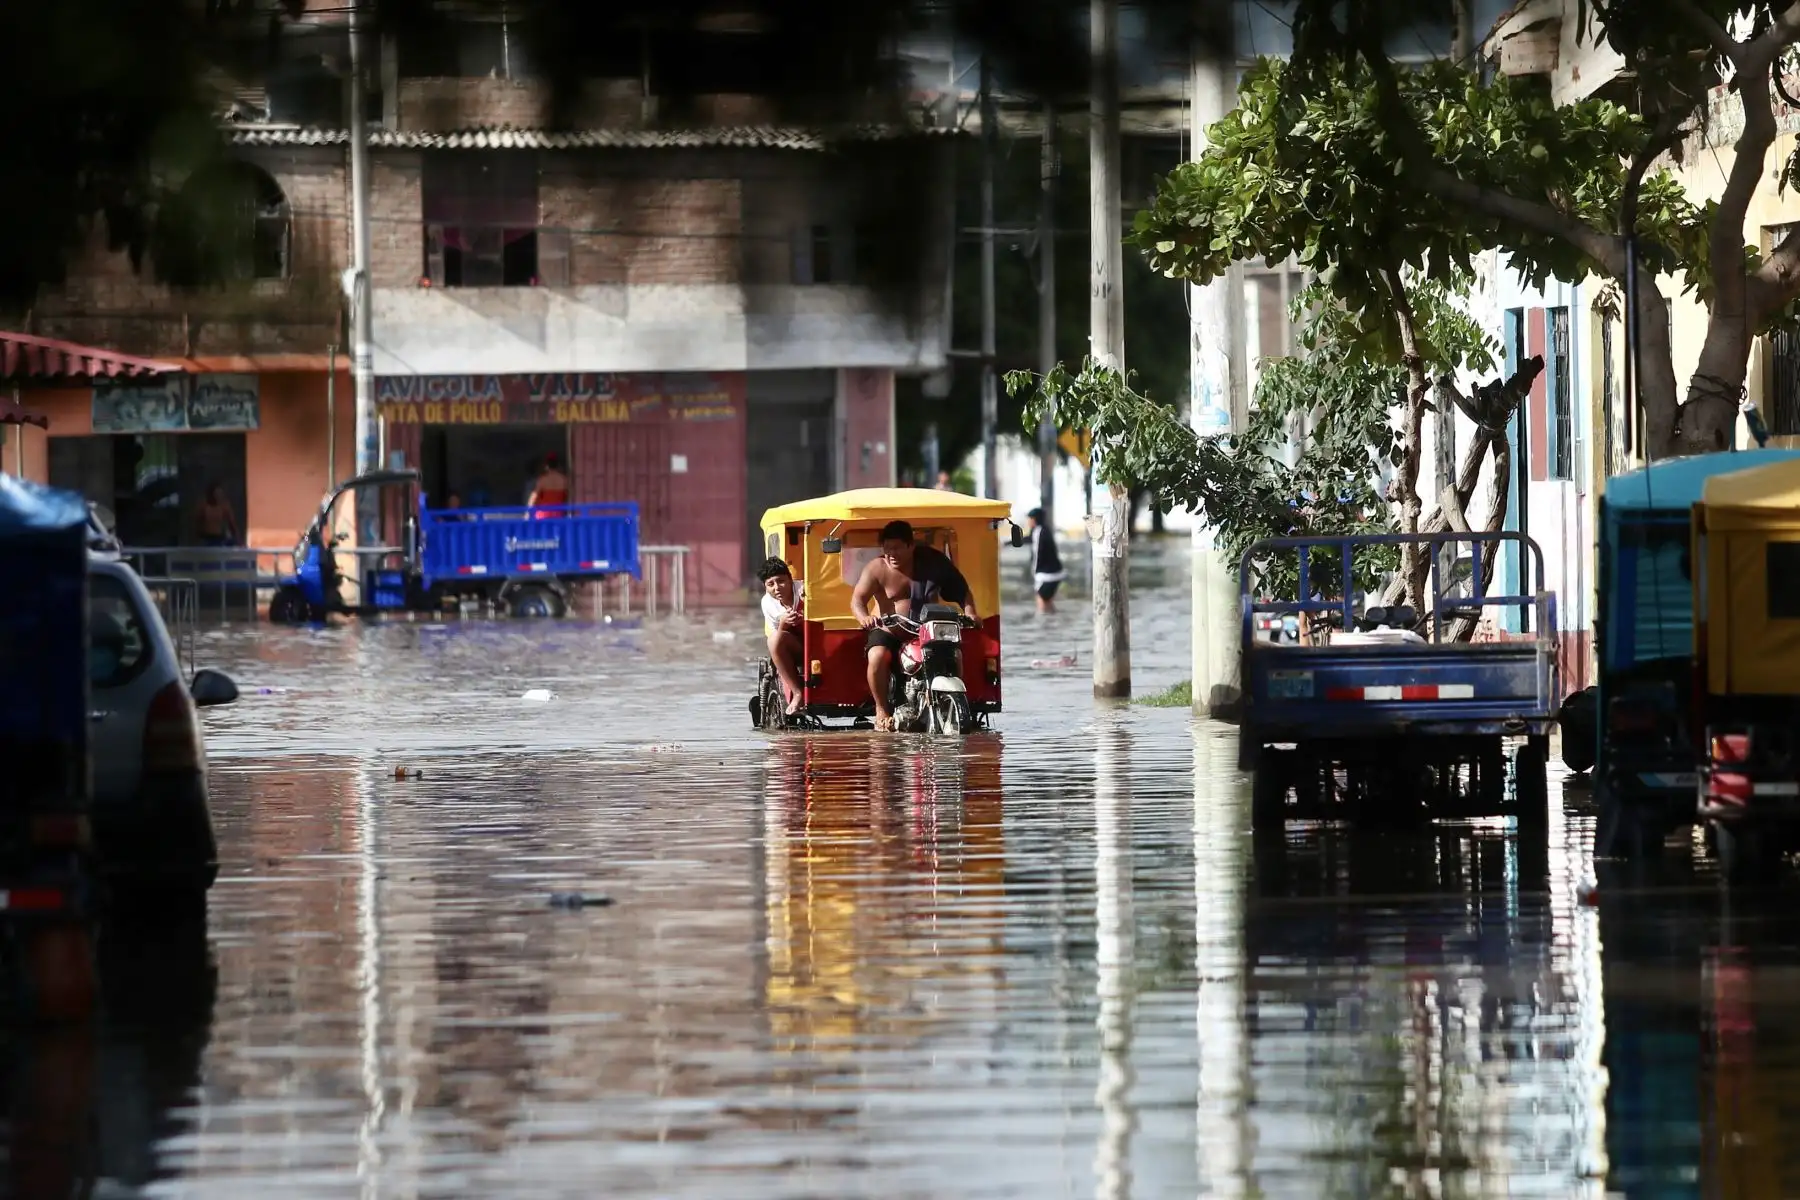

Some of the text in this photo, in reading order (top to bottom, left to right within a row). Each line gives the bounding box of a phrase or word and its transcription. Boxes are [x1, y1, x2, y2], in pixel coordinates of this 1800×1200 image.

[378, 374, 504, 402] AVICOLA
[424, 401, 445, 424] DE
[449, 400, 502, 424] POLLO
[555, 399, 630, 423] GALLINA
